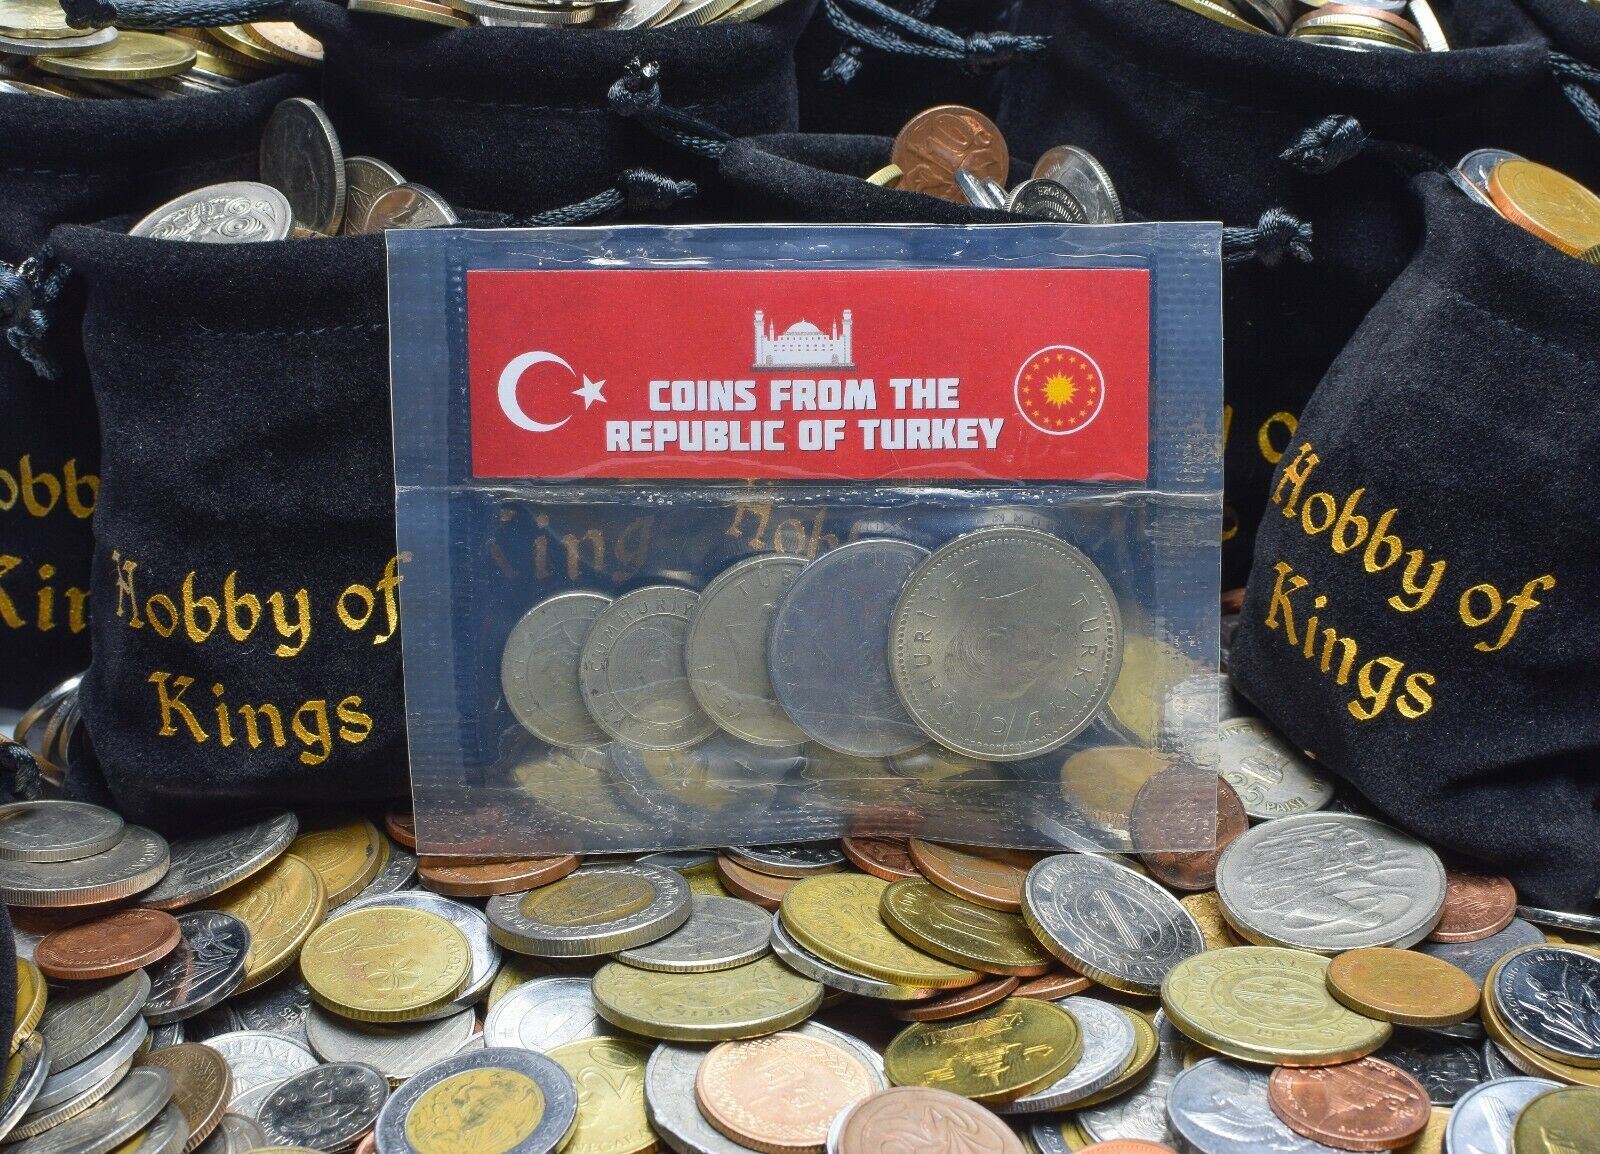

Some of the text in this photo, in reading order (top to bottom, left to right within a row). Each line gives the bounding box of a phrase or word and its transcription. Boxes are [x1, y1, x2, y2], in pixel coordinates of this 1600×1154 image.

[604, 417, 1005, 453] REPUBLIC OF TURKEY
[647, 377, 960, 412] COINS FROM THE
[1271, 442, 1557, 653] Hobby of
[111, 549, 414, 659] Hobby of
[1264, 560, 1438, 722] Kings
[148, 671, 375, 767] Kings
